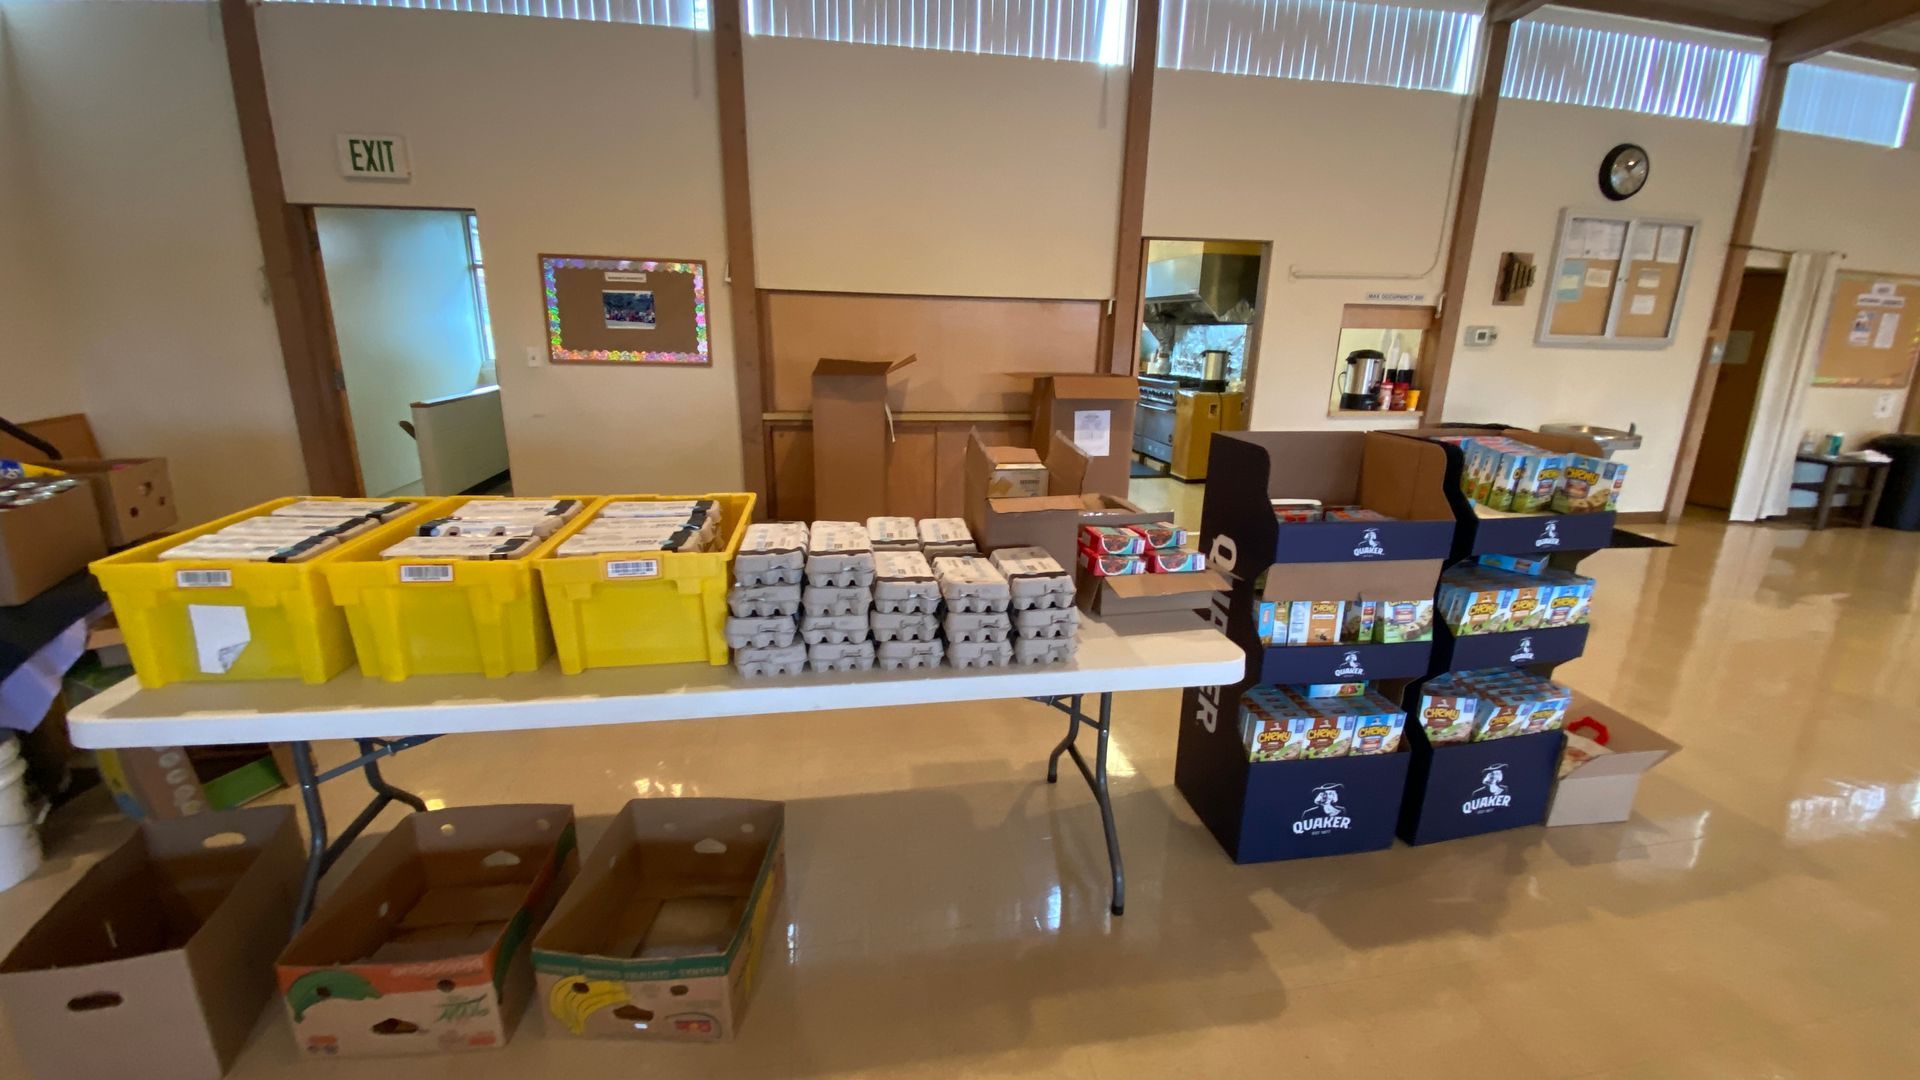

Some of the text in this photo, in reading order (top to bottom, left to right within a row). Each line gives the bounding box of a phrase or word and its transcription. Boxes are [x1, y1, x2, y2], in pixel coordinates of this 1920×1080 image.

[349, 139, 394, 172] EXIT
[1565, 466, 1599, 485] CHEWY
[1353, 547, 1383, 557] QUAKER
[1335, 667, 1363, 677] QUAKER
[1424, 708, 1460, 721] CHEWY
[1257, 730, 1292, 743] CHEWY
[1306, 727, 1341, 740] CHEWY
[1358, 725, 1392, 738] CHEWY
[1462, 795, 1511, 814] QUAKER
[1292, 816, 1351, 834] QUAKER
